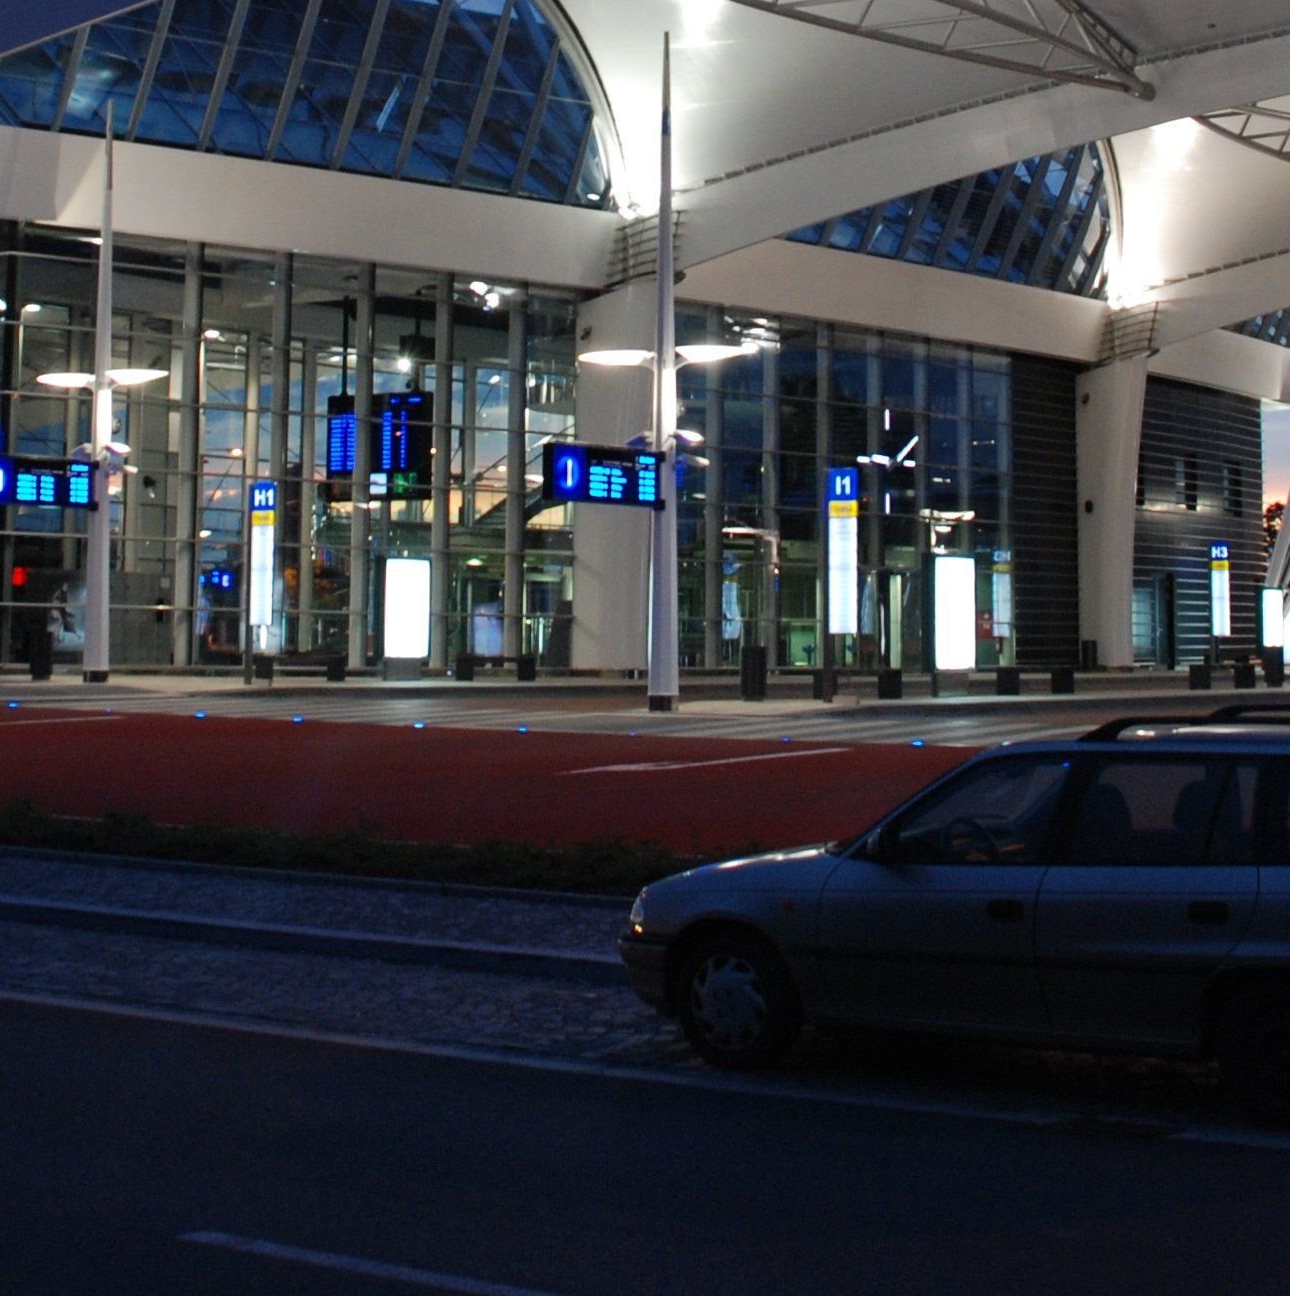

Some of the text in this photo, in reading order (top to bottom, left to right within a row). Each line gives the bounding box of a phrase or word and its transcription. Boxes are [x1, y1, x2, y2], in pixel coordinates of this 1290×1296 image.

[835, 475, 851, 495] I1
[254, 489, 274, 507] H1
[1211, 546, 1228, 559] H3
